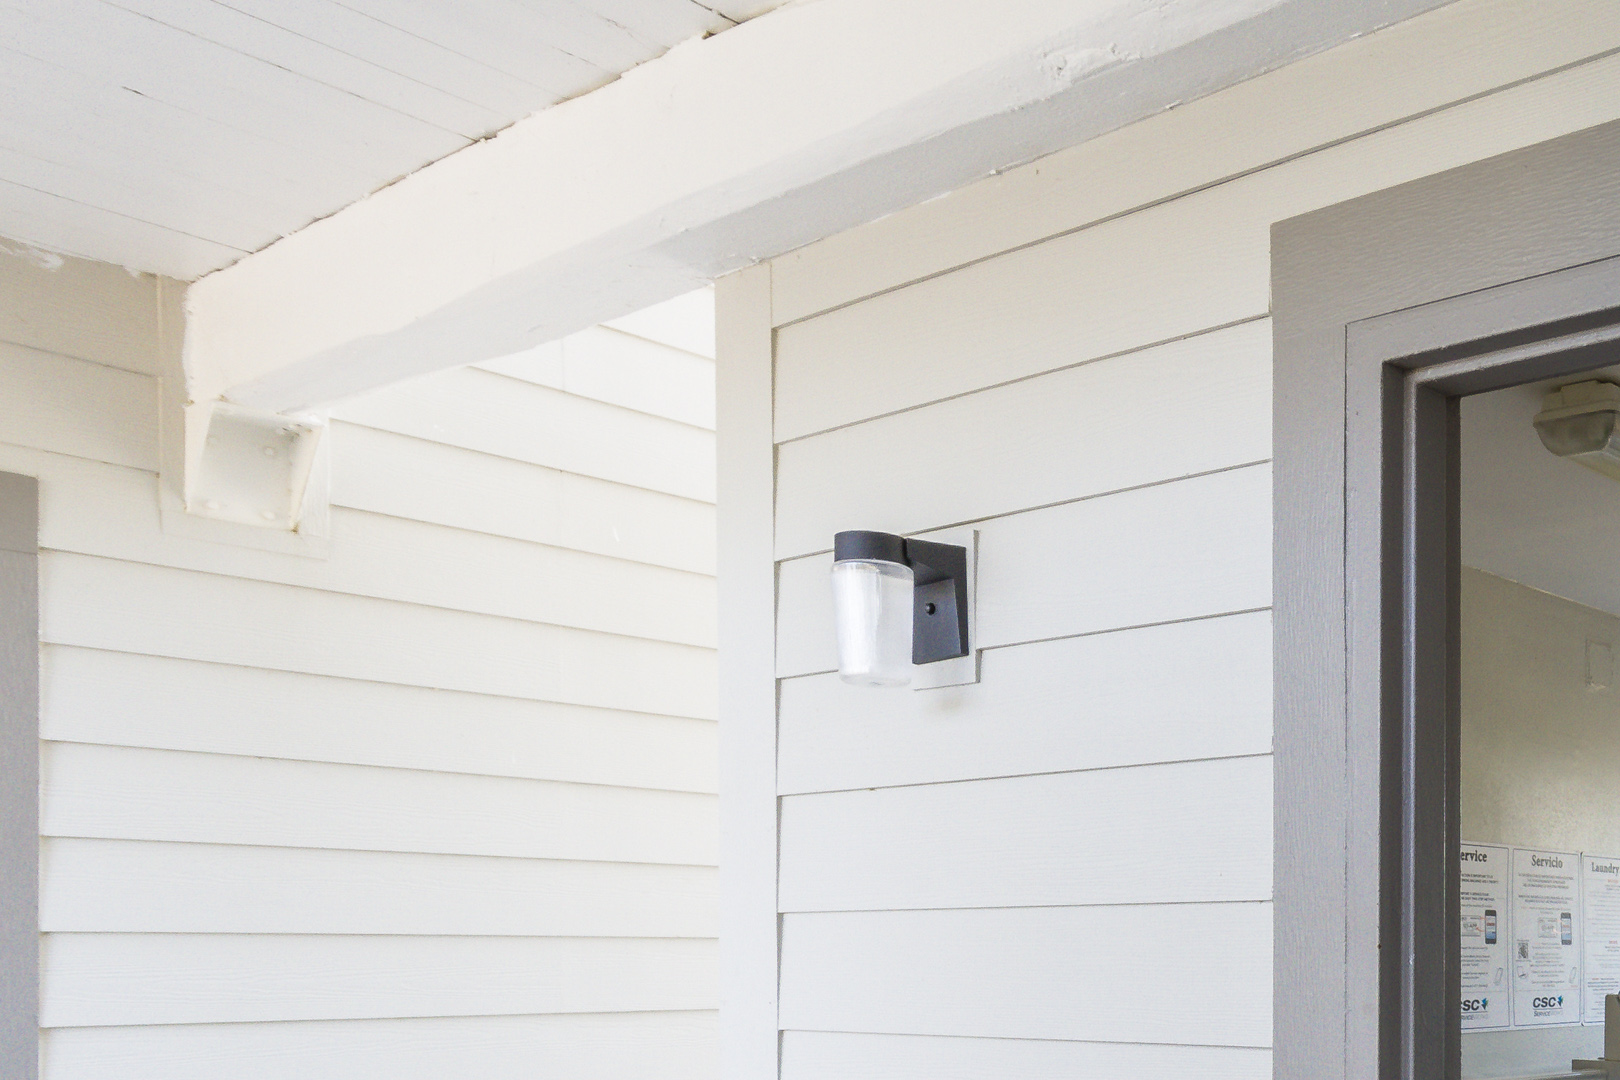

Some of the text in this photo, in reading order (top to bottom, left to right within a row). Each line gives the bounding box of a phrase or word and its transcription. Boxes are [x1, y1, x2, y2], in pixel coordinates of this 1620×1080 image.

[1460, 850, 1488, 863] ervice
[1531, 854, 1563, 869] Servicio
[1591, 862, 1620, 877] Laundry
[1532, 996, 1557, 1008] CSC
